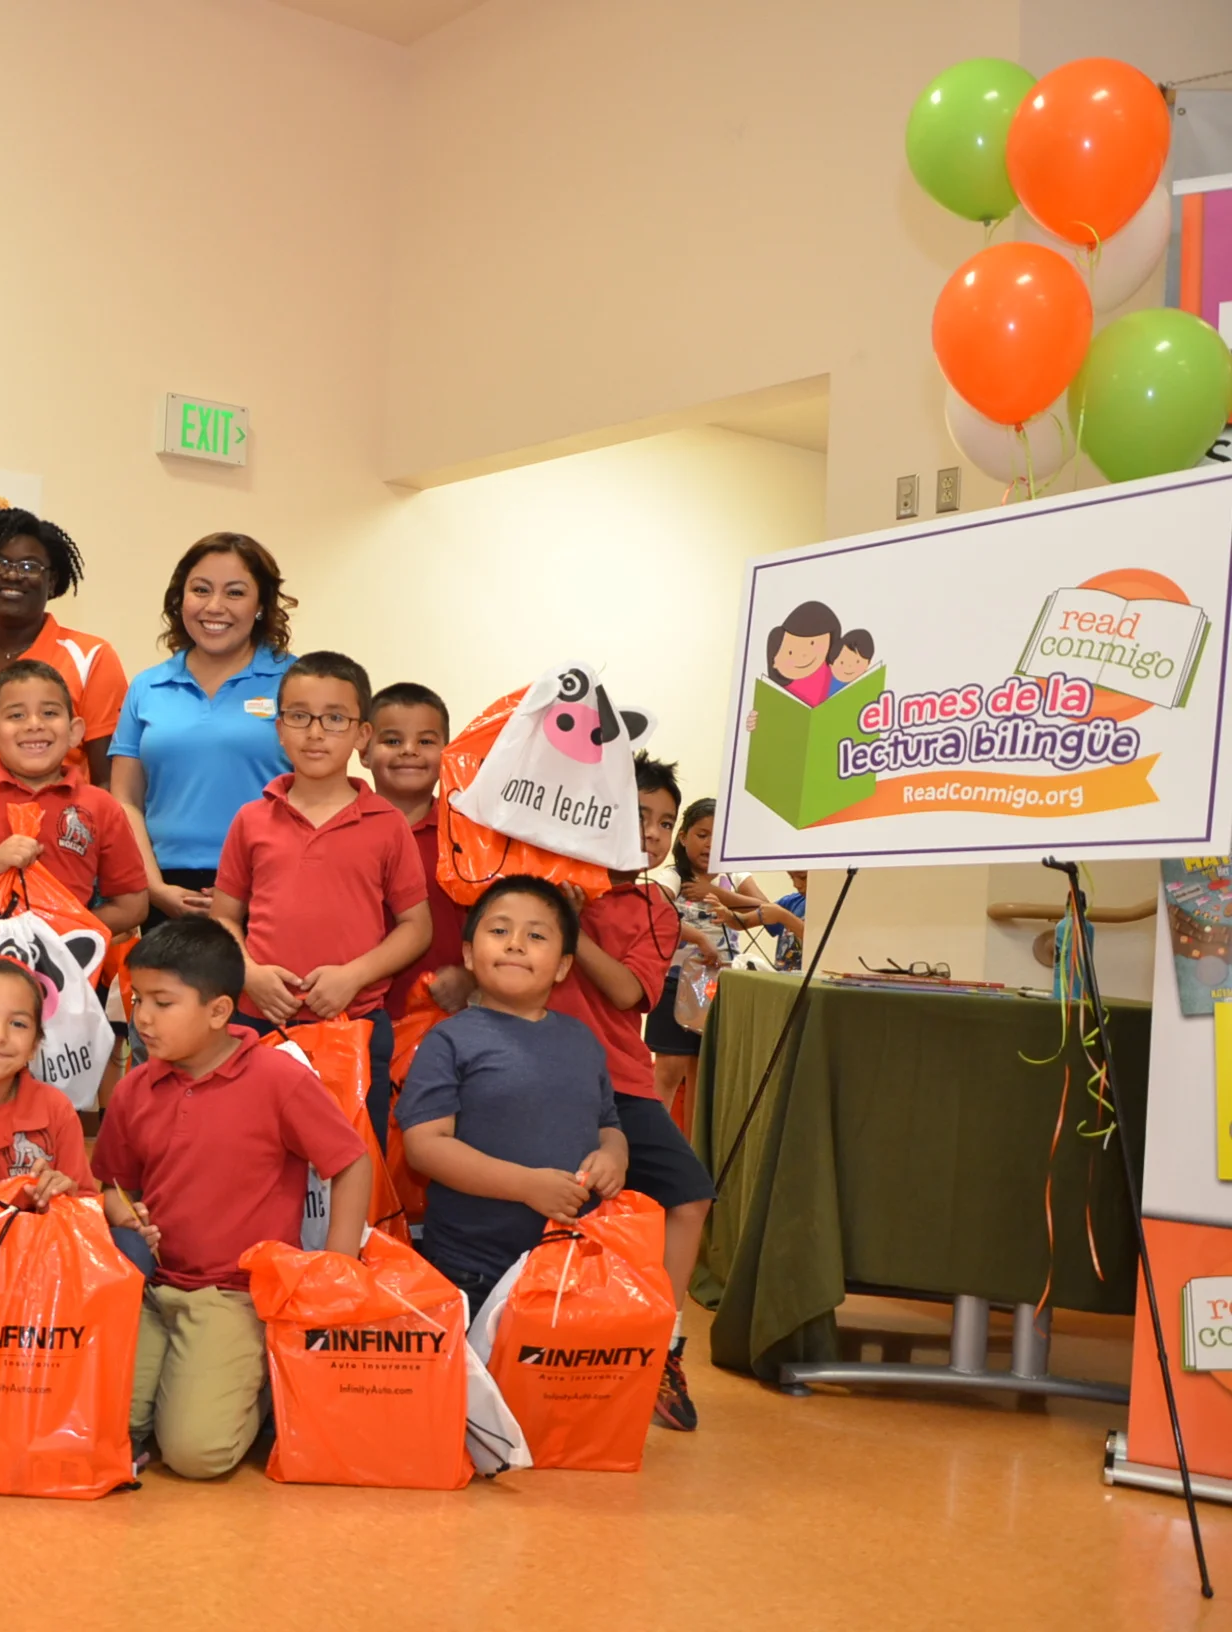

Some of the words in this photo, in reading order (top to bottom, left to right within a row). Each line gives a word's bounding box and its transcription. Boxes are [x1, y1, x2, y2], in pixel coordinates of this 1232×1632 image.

[181, 403, 234, 455] EXIT
[1059, 610, 1142, 640] read
[1040, 635, 1175, 680] conmigo
[862, 697, 890, 729] el
[902, 687, 979, 722] mes
[990, 683, 1036, 713] de
[1049, 677, 1088, 712] la
[842, 731, 962, 773] lectura
[974, 720, 1134, 763] bilingüe
[551, 784, 613, 830] leche
[903, 783, 1084, 808] ReadConmigo.org
[40, 1043, 92, 1083] leche
[331, 1329, 446, 1353] INFINITY
[545, 1347, 656, 1368] INFINITY
[330, 1361, 358, 1370] Auto
[362, 1361, 422, 1371] Insurance
[338, 1383, 414, 1396] InfinityAuto.com
